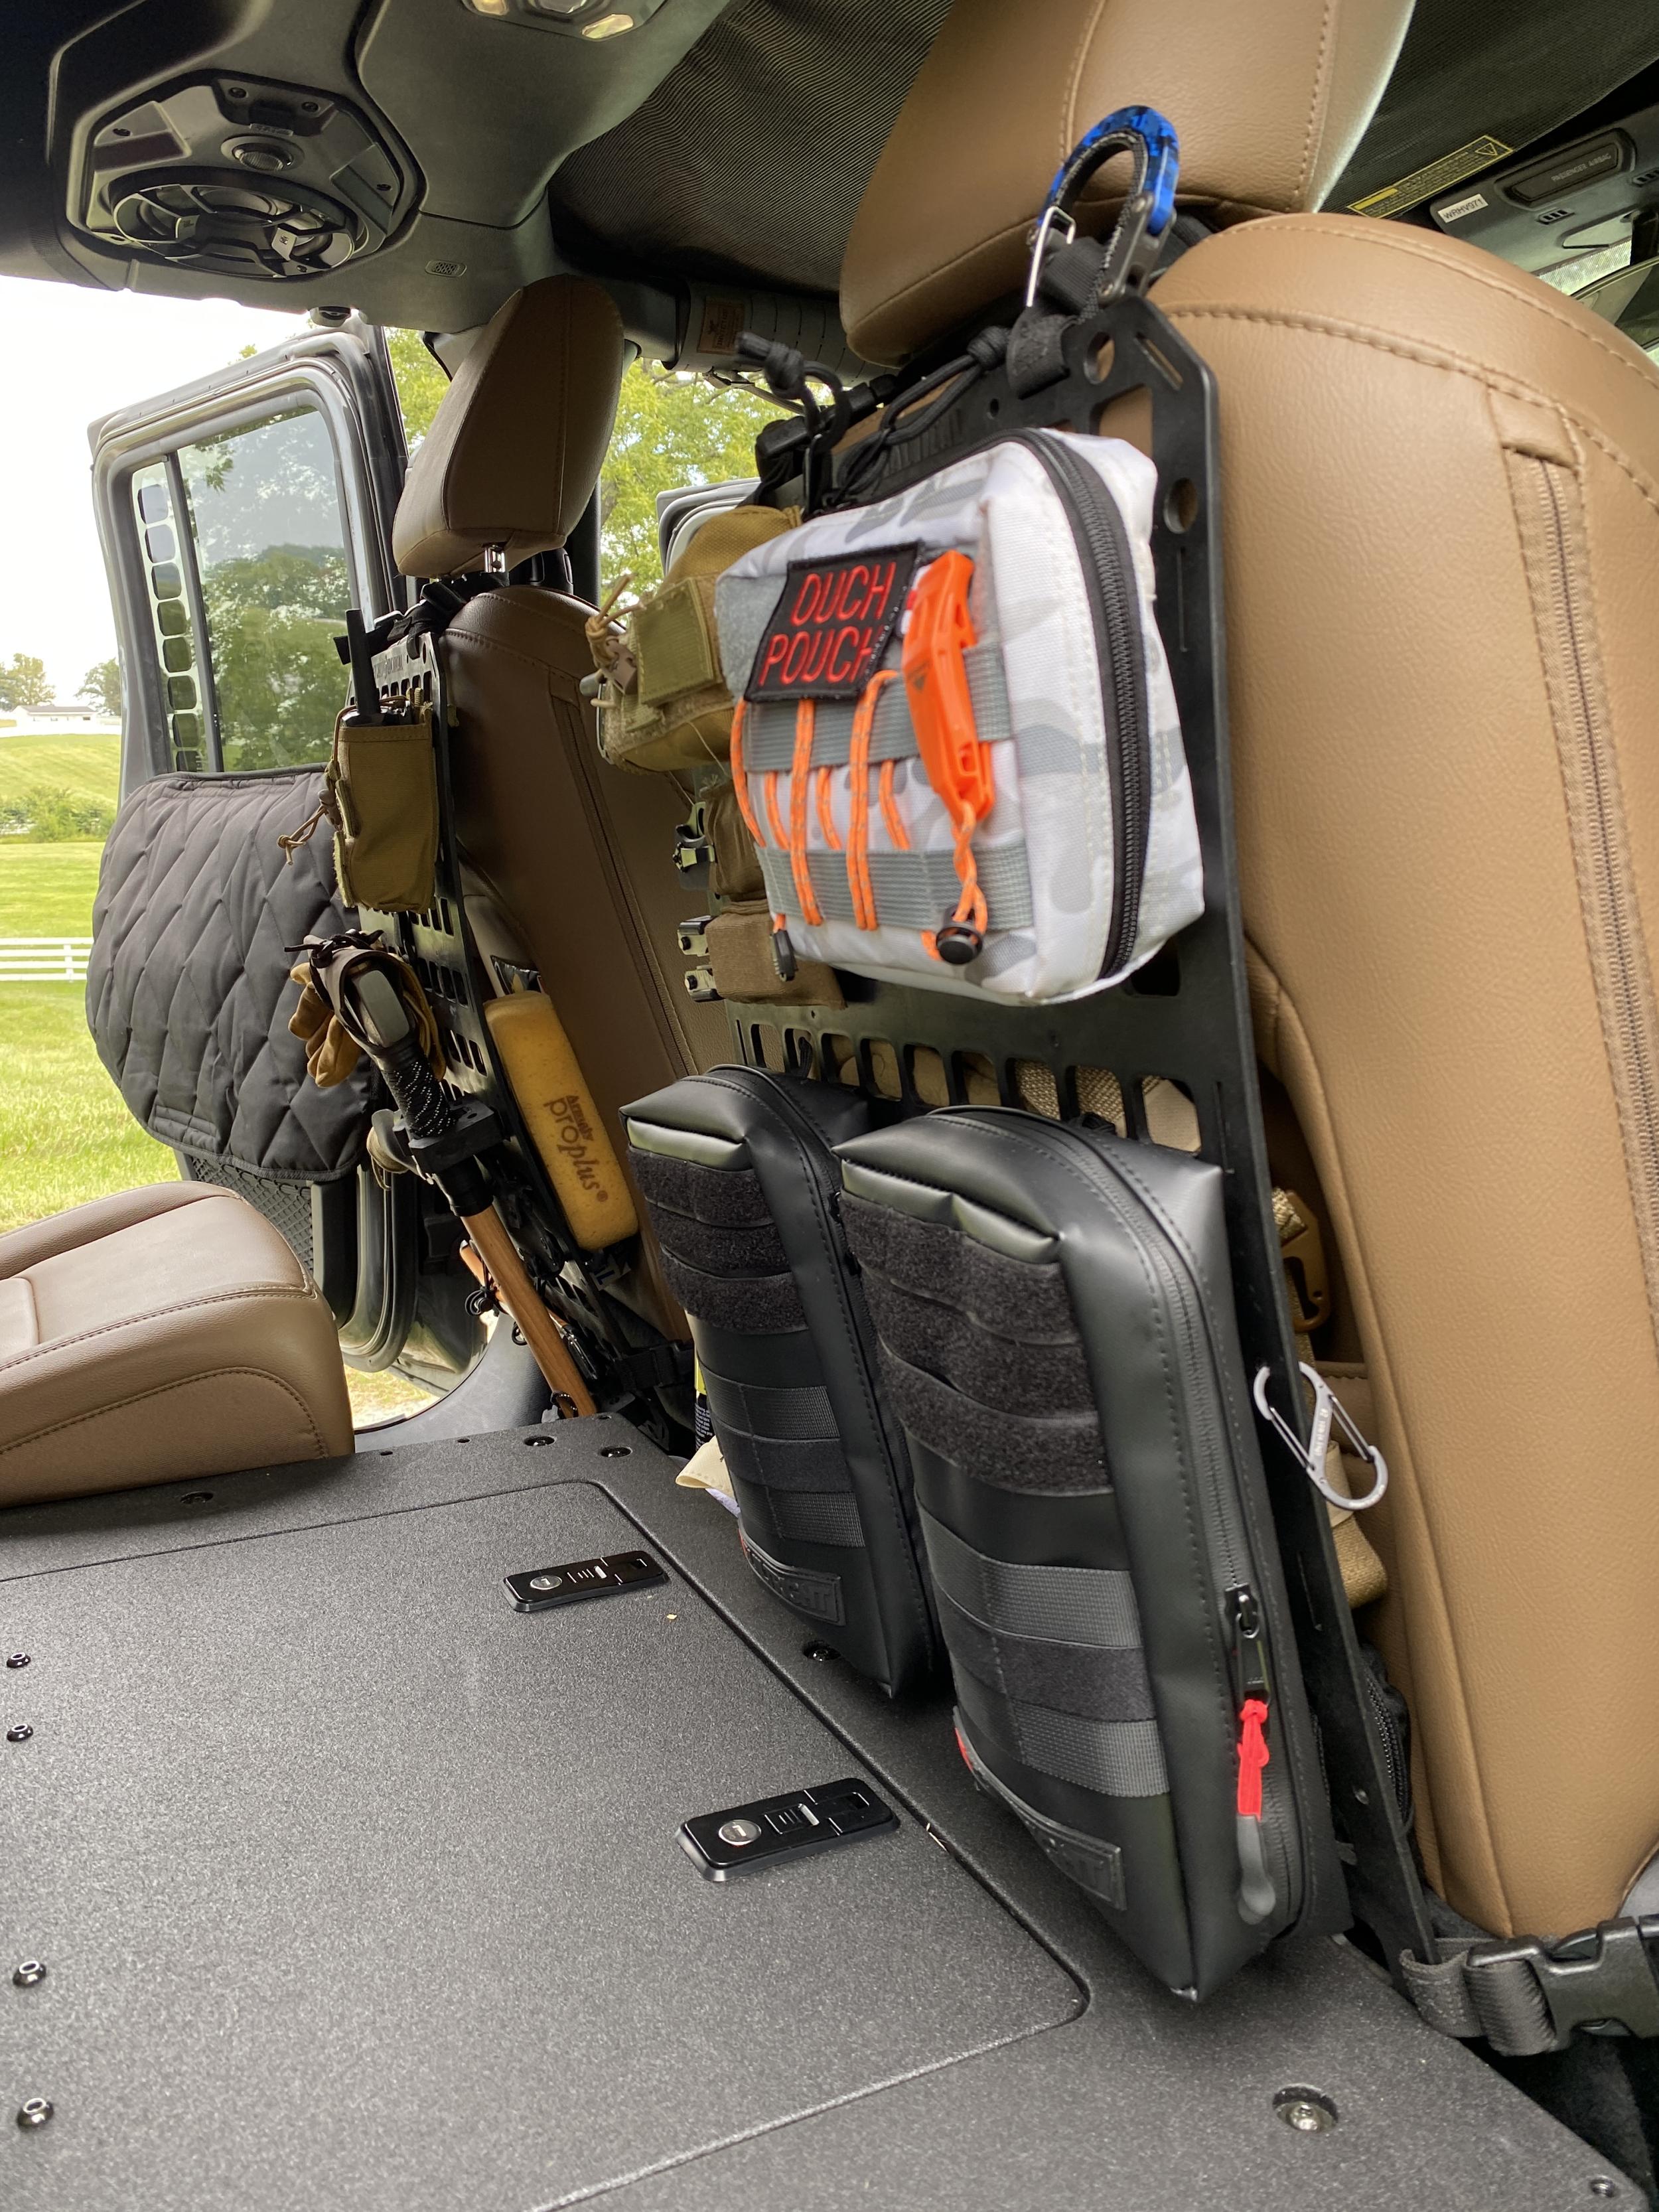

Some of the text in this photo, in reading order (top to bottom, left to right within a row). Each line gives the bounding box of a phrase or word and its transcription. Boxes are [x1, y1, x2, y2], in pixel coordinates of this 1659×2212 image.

[1443, 198, 1484, 219] WRHV971
[790, 561, 897, 627] OUCH
[758, 625, 883, 686] POUCH
